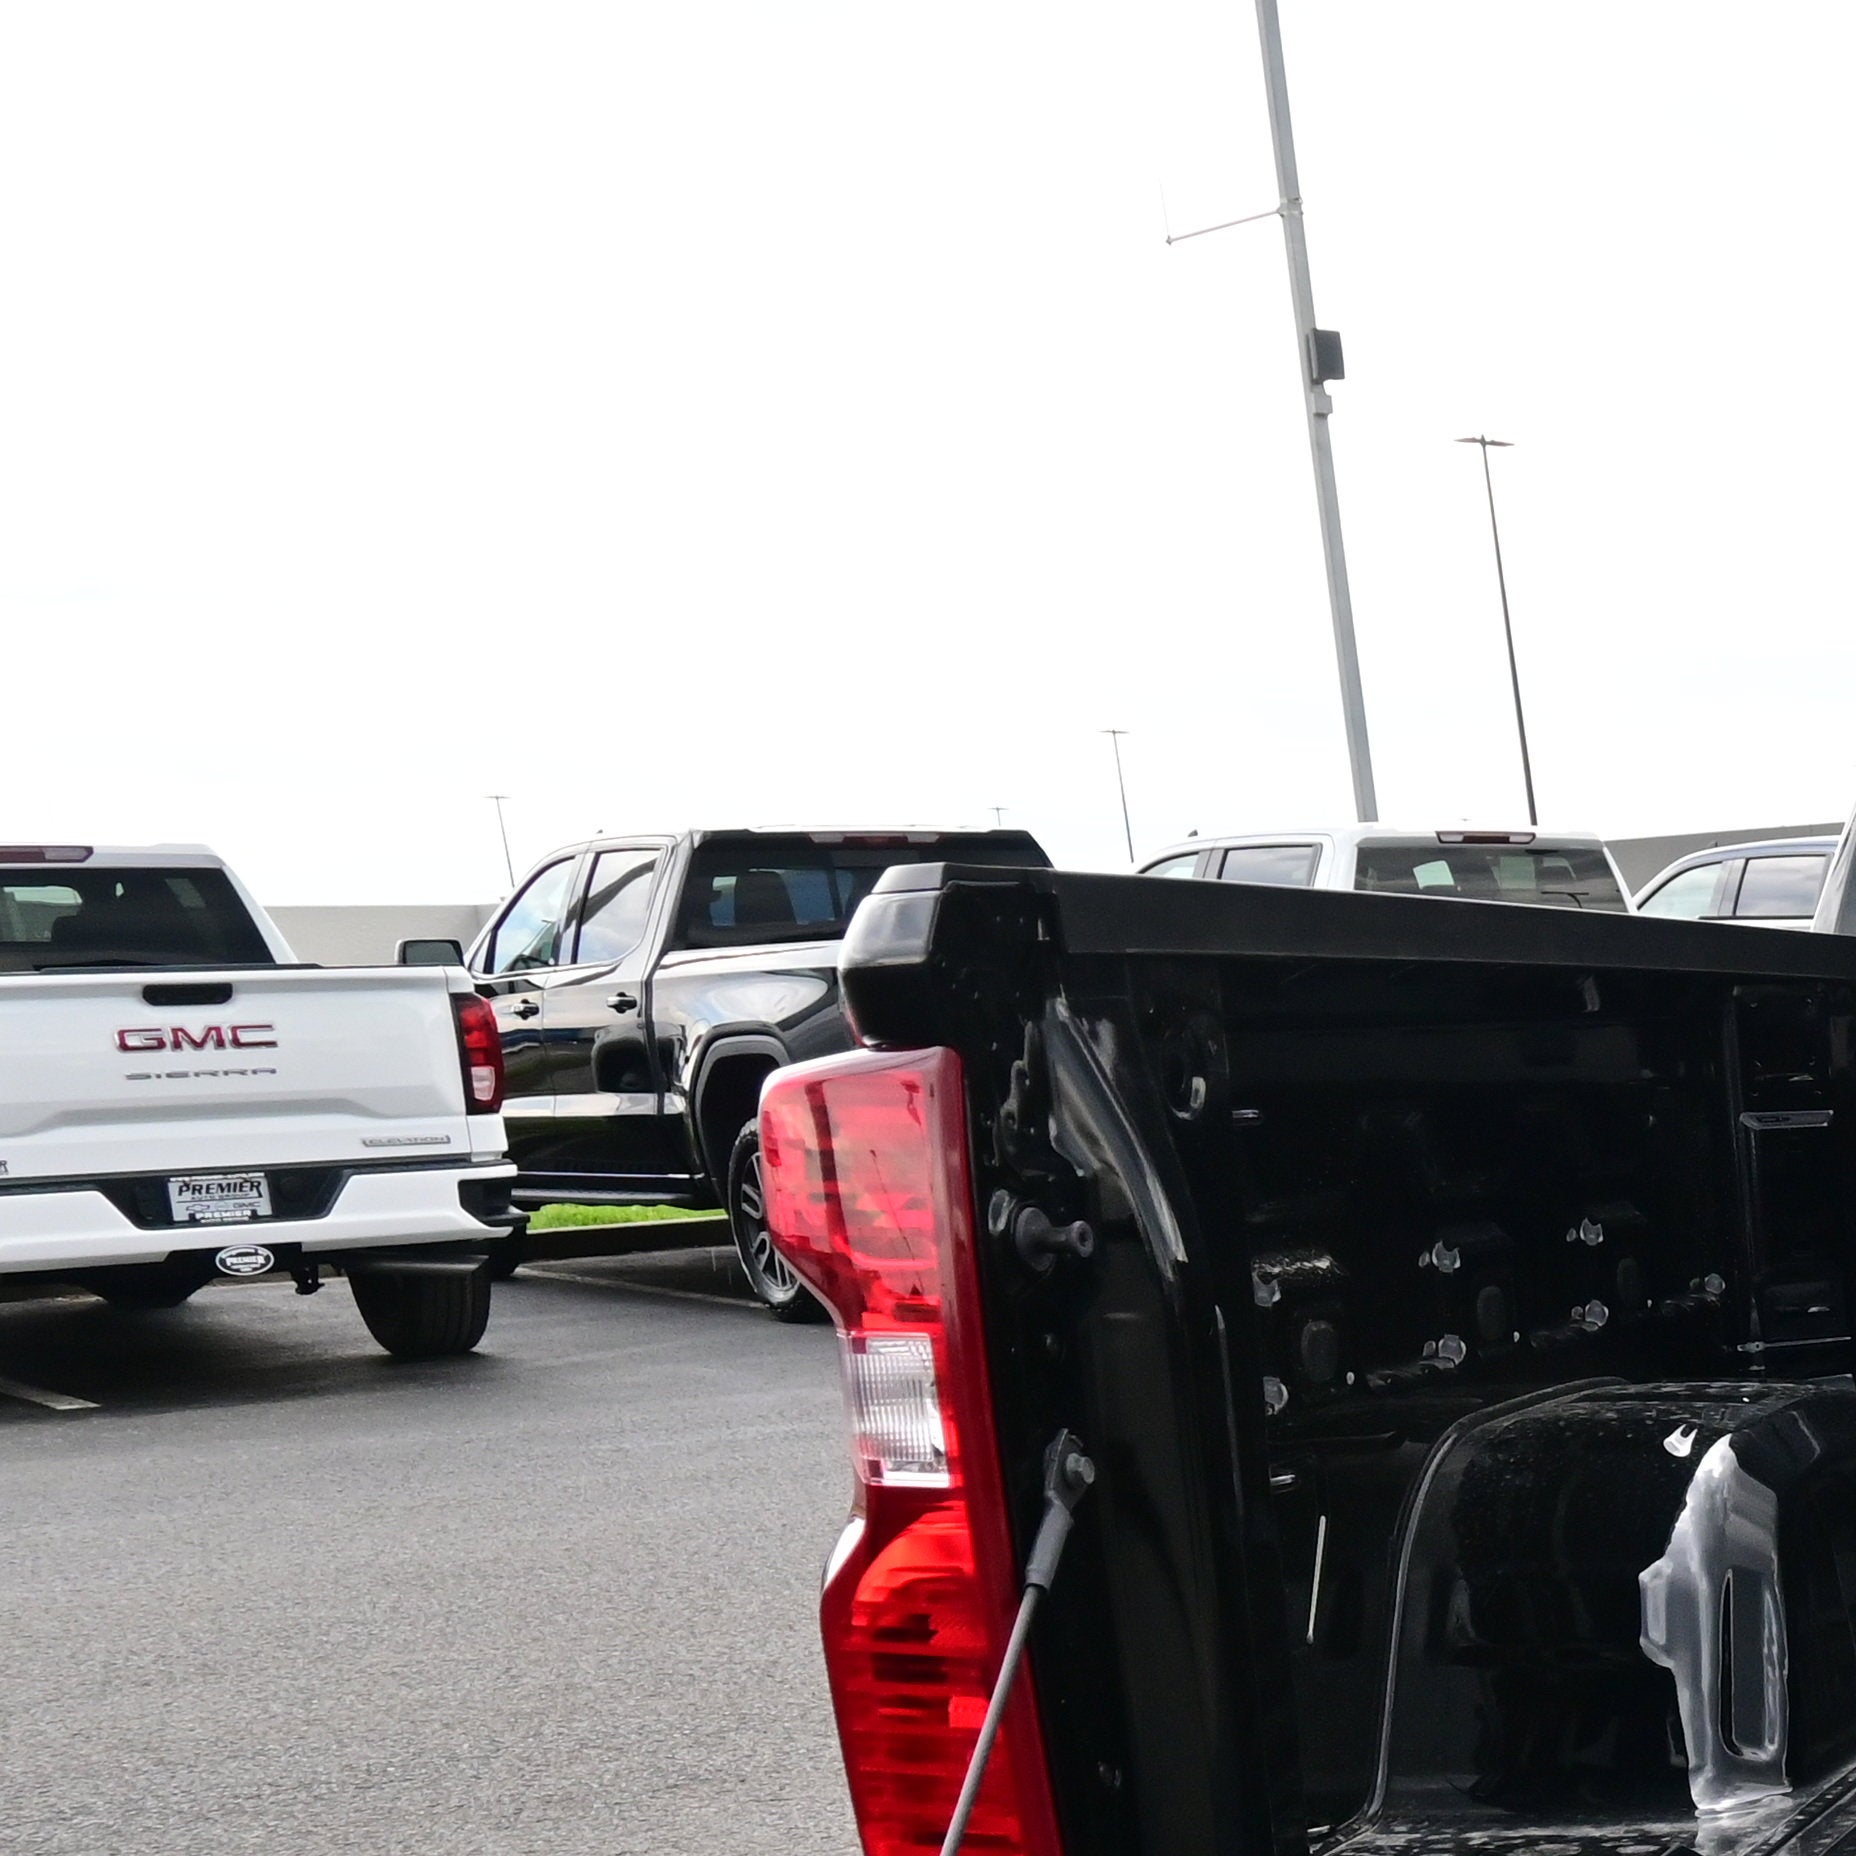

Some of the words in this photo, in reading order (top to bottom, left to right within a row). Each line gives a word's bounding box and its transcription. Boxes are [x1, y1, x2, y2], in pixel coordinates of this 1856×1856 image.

[114, 1023, 279, 1053] GMC
[125, 1067, 278, 1081] SIERRA
[178, 1180, 263, 1198] PREMIER
[195, 1209, 252, 1220] PREMIER
